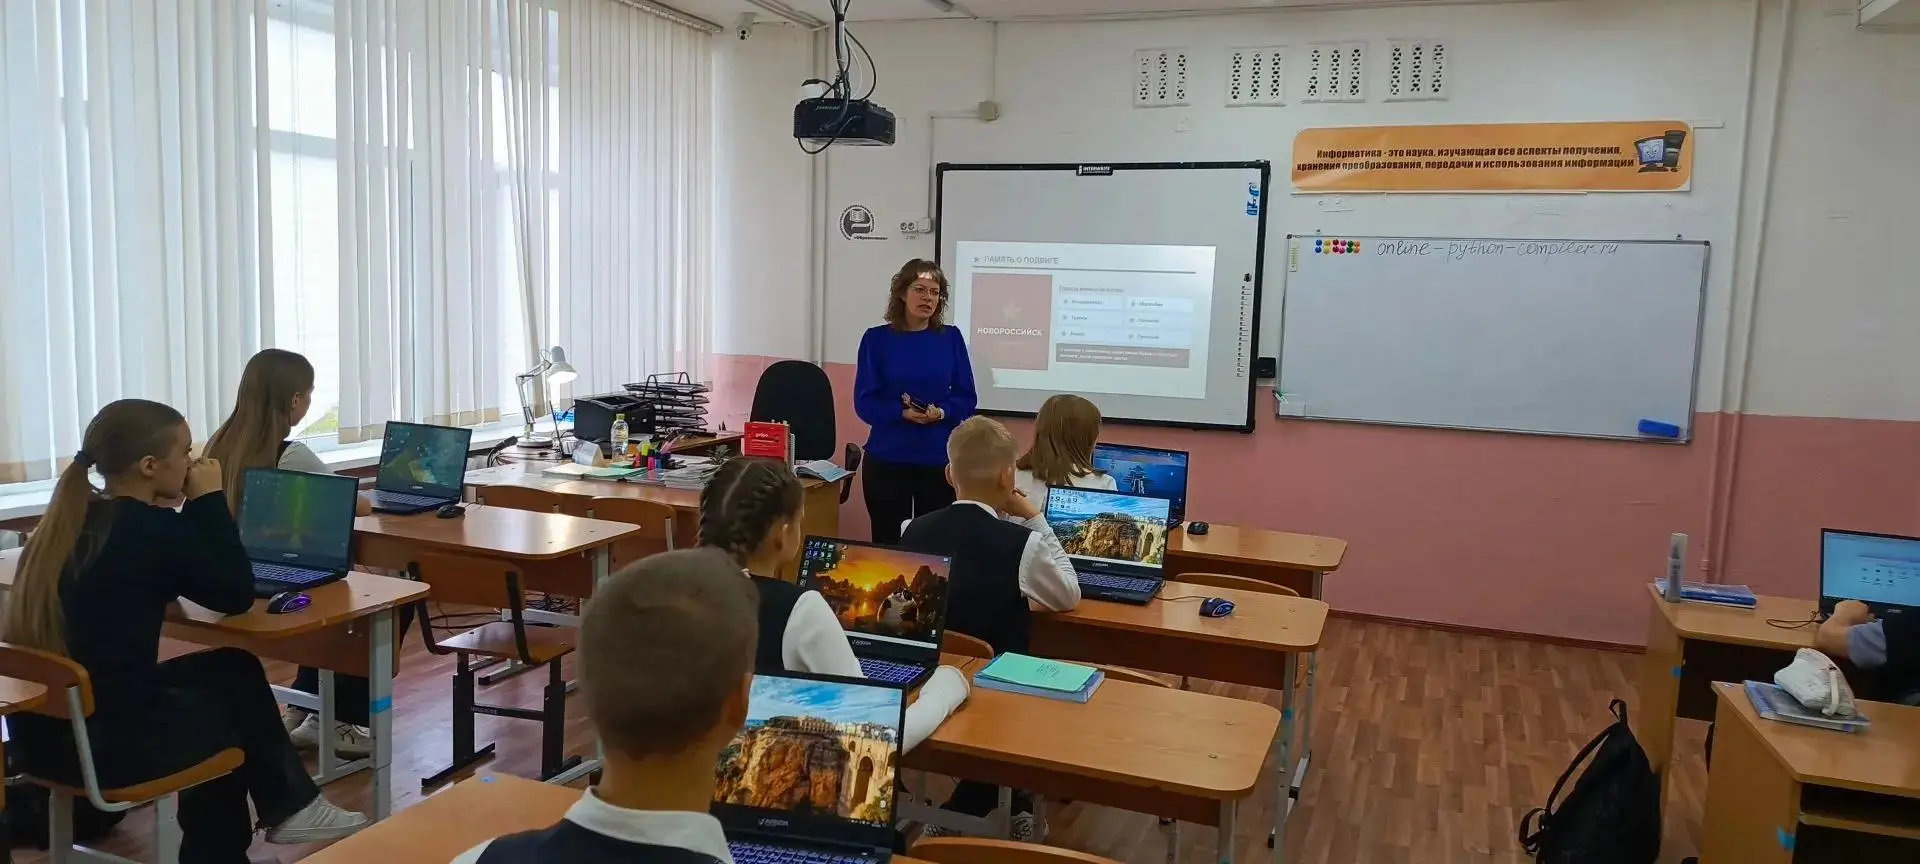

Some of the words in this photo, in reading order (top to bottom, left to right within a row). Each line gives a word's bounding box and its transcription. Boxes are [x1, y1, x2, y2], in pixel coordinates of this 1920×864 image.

[1316, 148, 1382, 158] Информатика
[1388, 148, 1404, 157] это
[1437, 147, 1496, 157] изучающая
[1497, 147, 1515, 156] все
[1516, 146, 1561, 156] аспекты
[1563, 145, 1621, 156] получения,
[1296, 163, 1341, 171] хранения
[1342, 161, 1423, 170] преобразования,
[1425, 160, 1473, 169] передачи
[1474, 160, 1482, 168] и
[1483, 159, 1563, 168] использования
[1564, 158, 1634, 168] информации
[984, 255, 1014, 263] ПАМЯТЬ
[1024, 256, 1059, 265] ПОДВИГЕ
[977, 326, 1042, 336] НОВОРОССИЙСК
